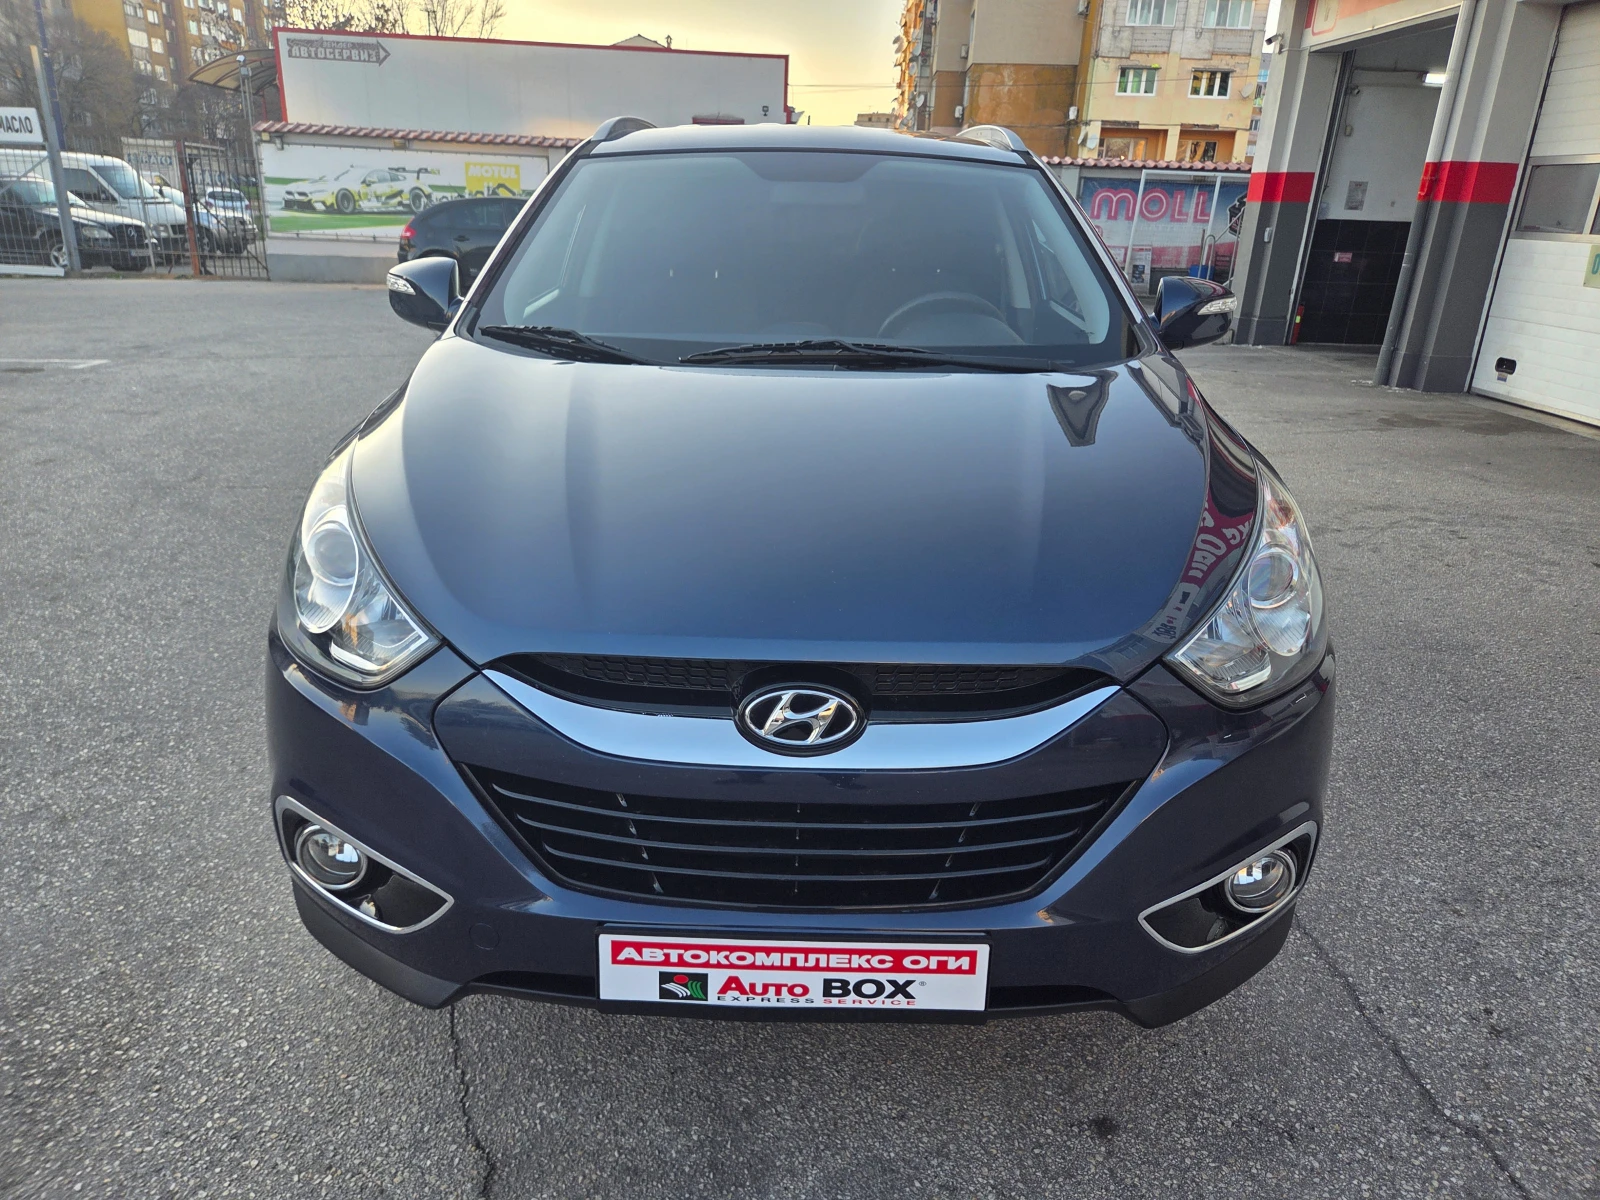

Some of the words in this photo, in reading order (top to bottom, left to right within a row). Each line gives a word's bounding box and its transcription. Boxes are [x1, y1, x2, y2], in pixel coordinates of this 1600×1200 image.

[291, 46, 377, 61] АВТОСЕРВИЗ
[468, 164, 518, 179] MOTUL
[616, 946, 895, 970] АВТОКОМПЛЕКС
[902, 954, 971, 971] ОГИ
[822, 978, 917, 1000] BOX
[717, 996, 815, 1004] EXPRESS
[823, 998, 917, 1006] SERVICE
